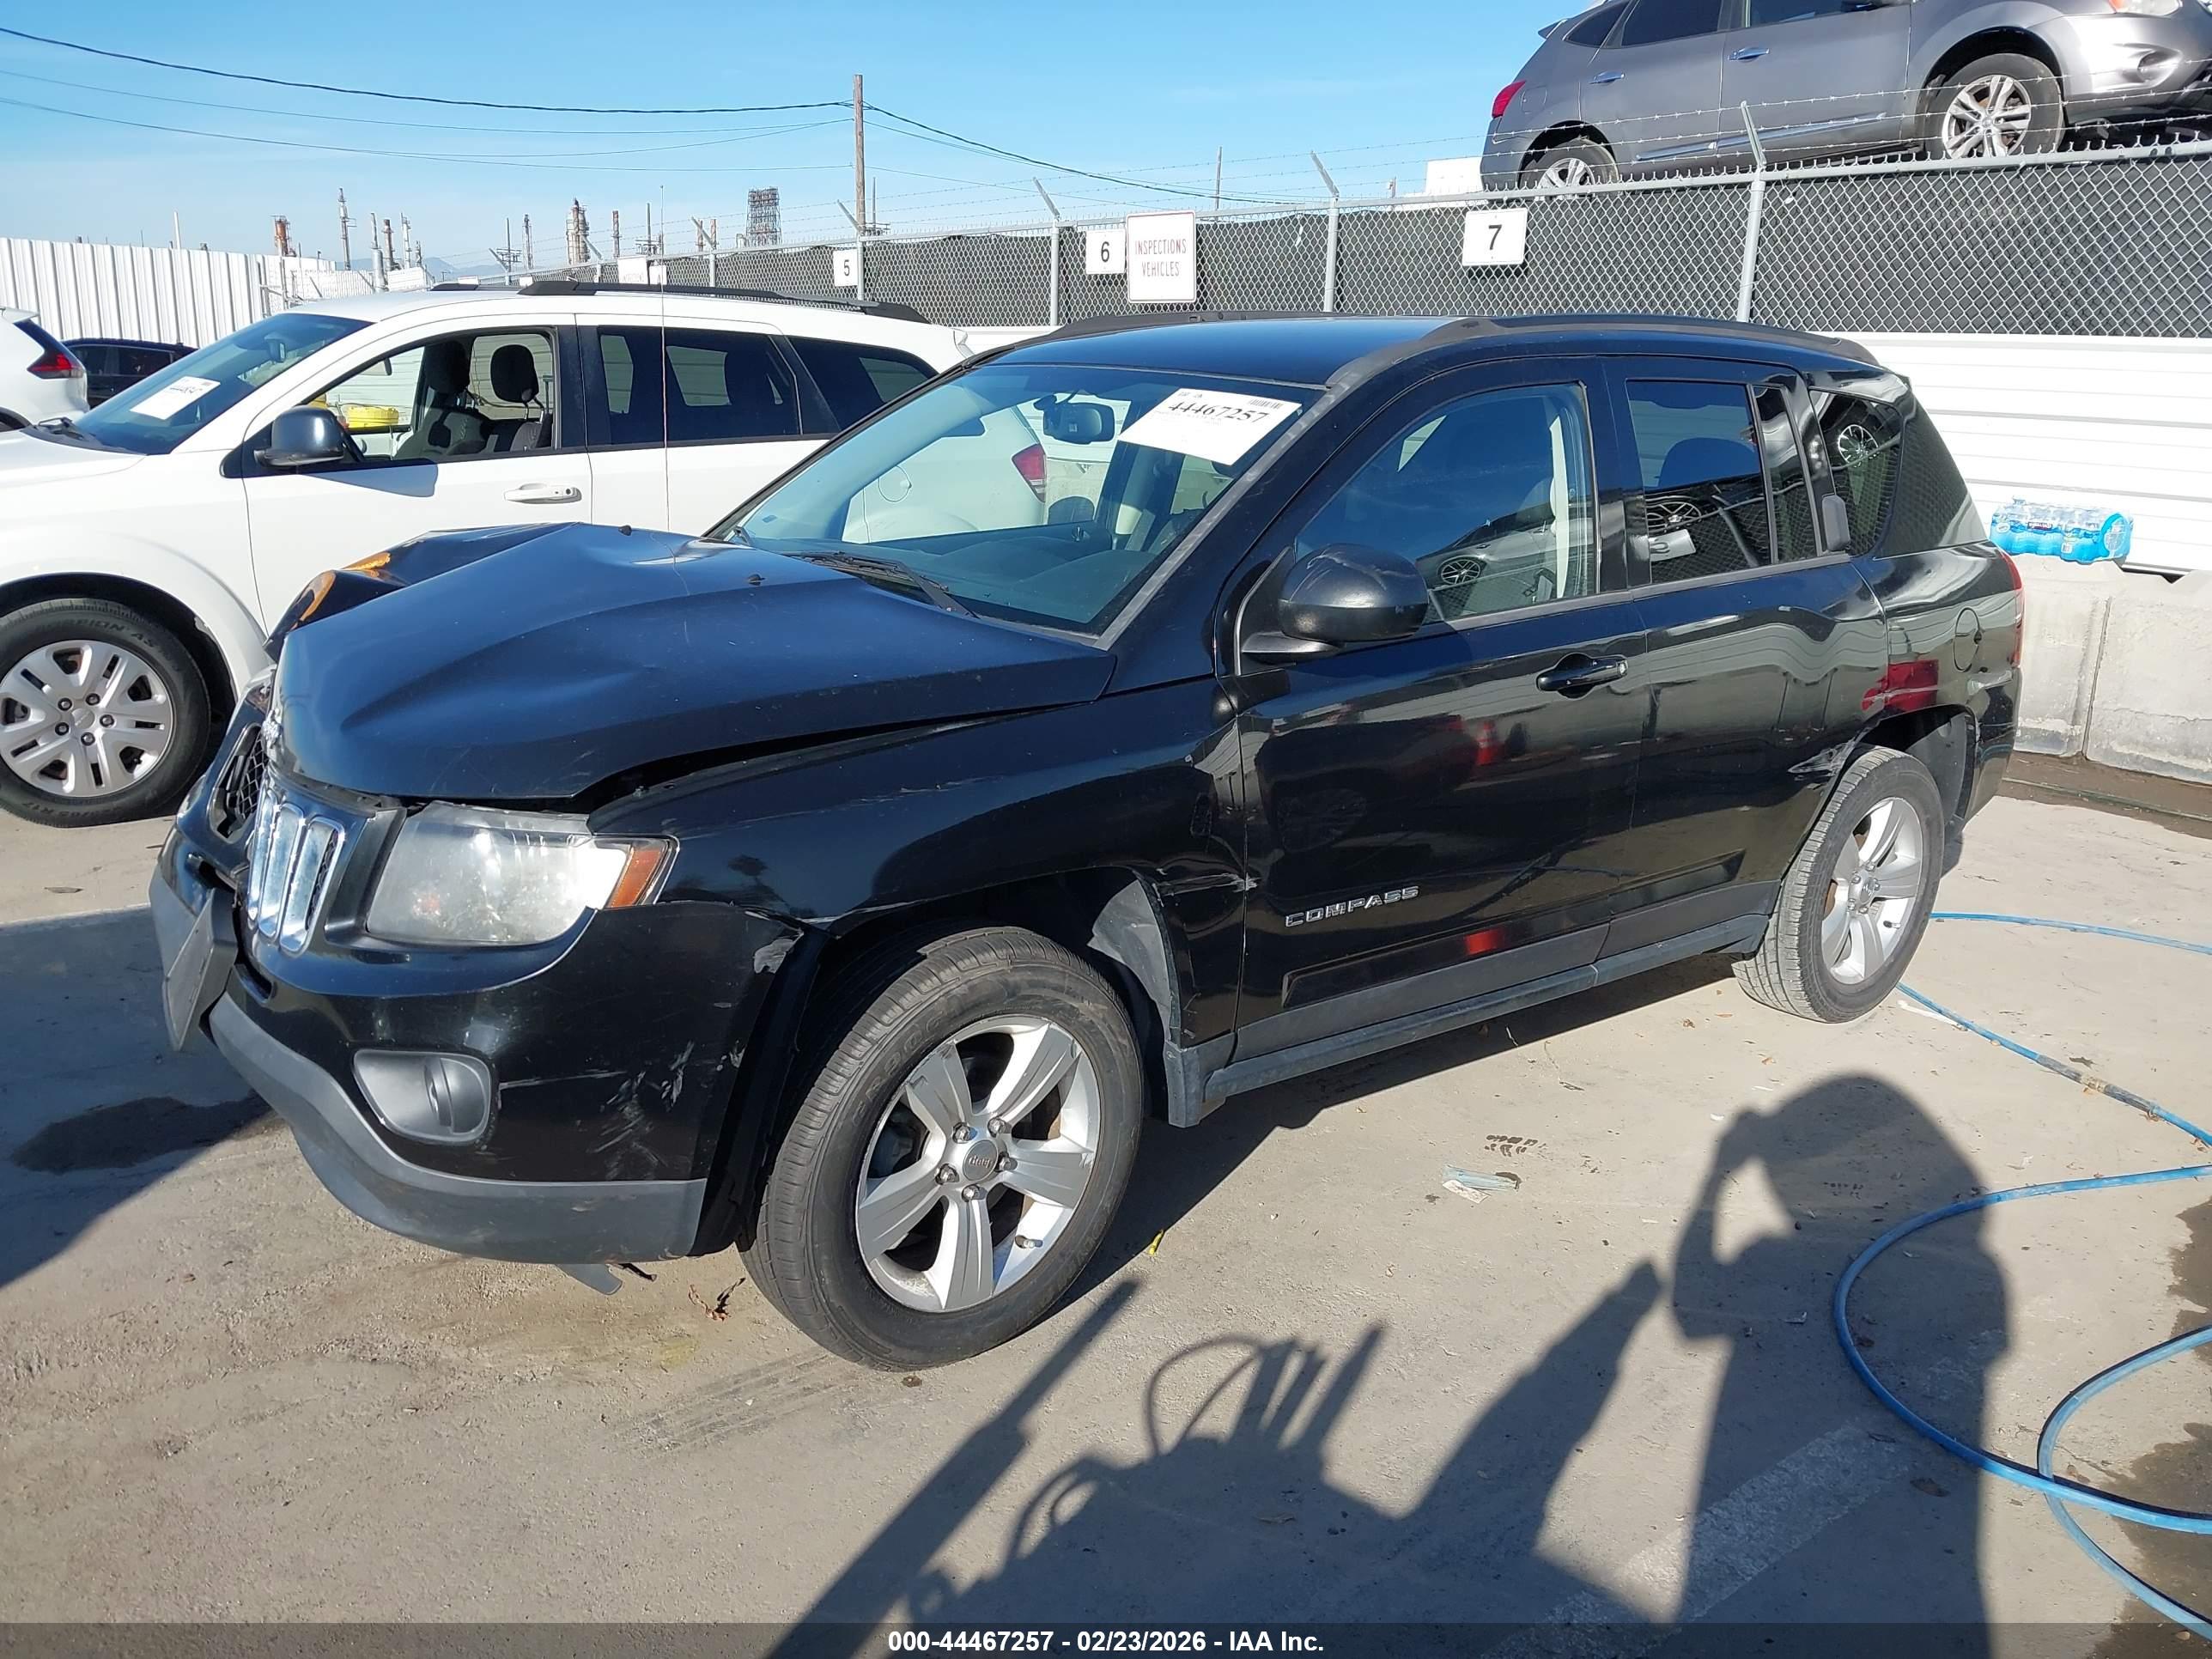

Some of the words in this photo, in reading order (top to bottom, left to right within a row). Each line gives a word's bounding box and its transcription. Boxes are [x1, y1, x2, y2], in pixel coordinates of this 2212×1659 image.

[1134, 239, 1187, 255] INSPECTIONS
[1488, 224, 1502, 250] 7
[1100, 240, 1110, 264] 6
[843, 258, 850, 277] 5
[1141, 261, 1180, 277] VEHICLES
[1168, 401, 1270, 423] 44467257
[1285, 885, 1419, 927] COMPASS
